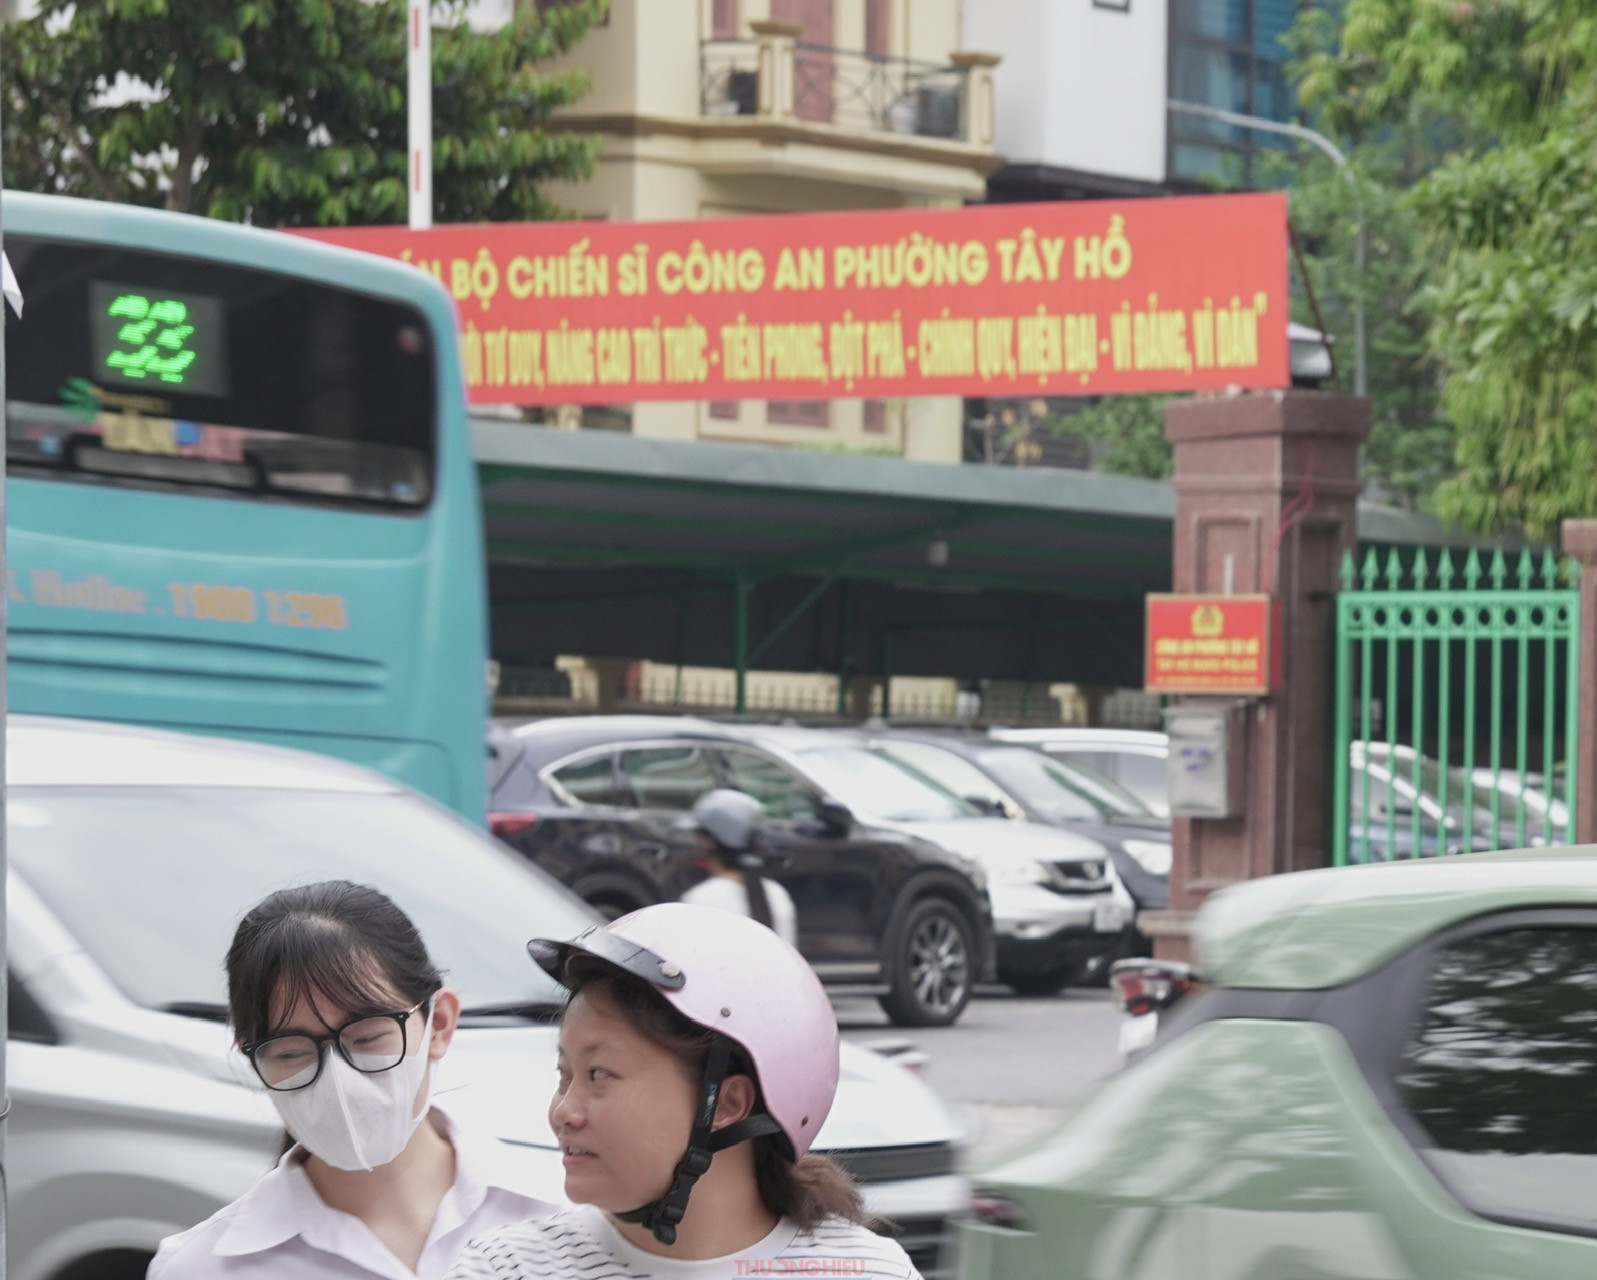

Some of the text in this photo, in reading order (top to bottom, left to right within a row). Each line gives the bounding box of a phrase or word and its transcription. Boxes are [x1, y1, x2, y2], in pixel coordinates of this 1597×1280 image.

[451, 246, 500, 311] BỘ
[506, 238, 610, 299] CHIẾN
[617, 244, 649, 296] SĨ
[656, 239, 766, 294] CÔNG
[774, 247, 825, 291] AN
[833, 232, 990, 289] PHƯỜNG
[995, 226, 1065, 283] TÂY
[1074, 212, 1132, 280] HỒ
[596, 327, 631, 385] CAO
